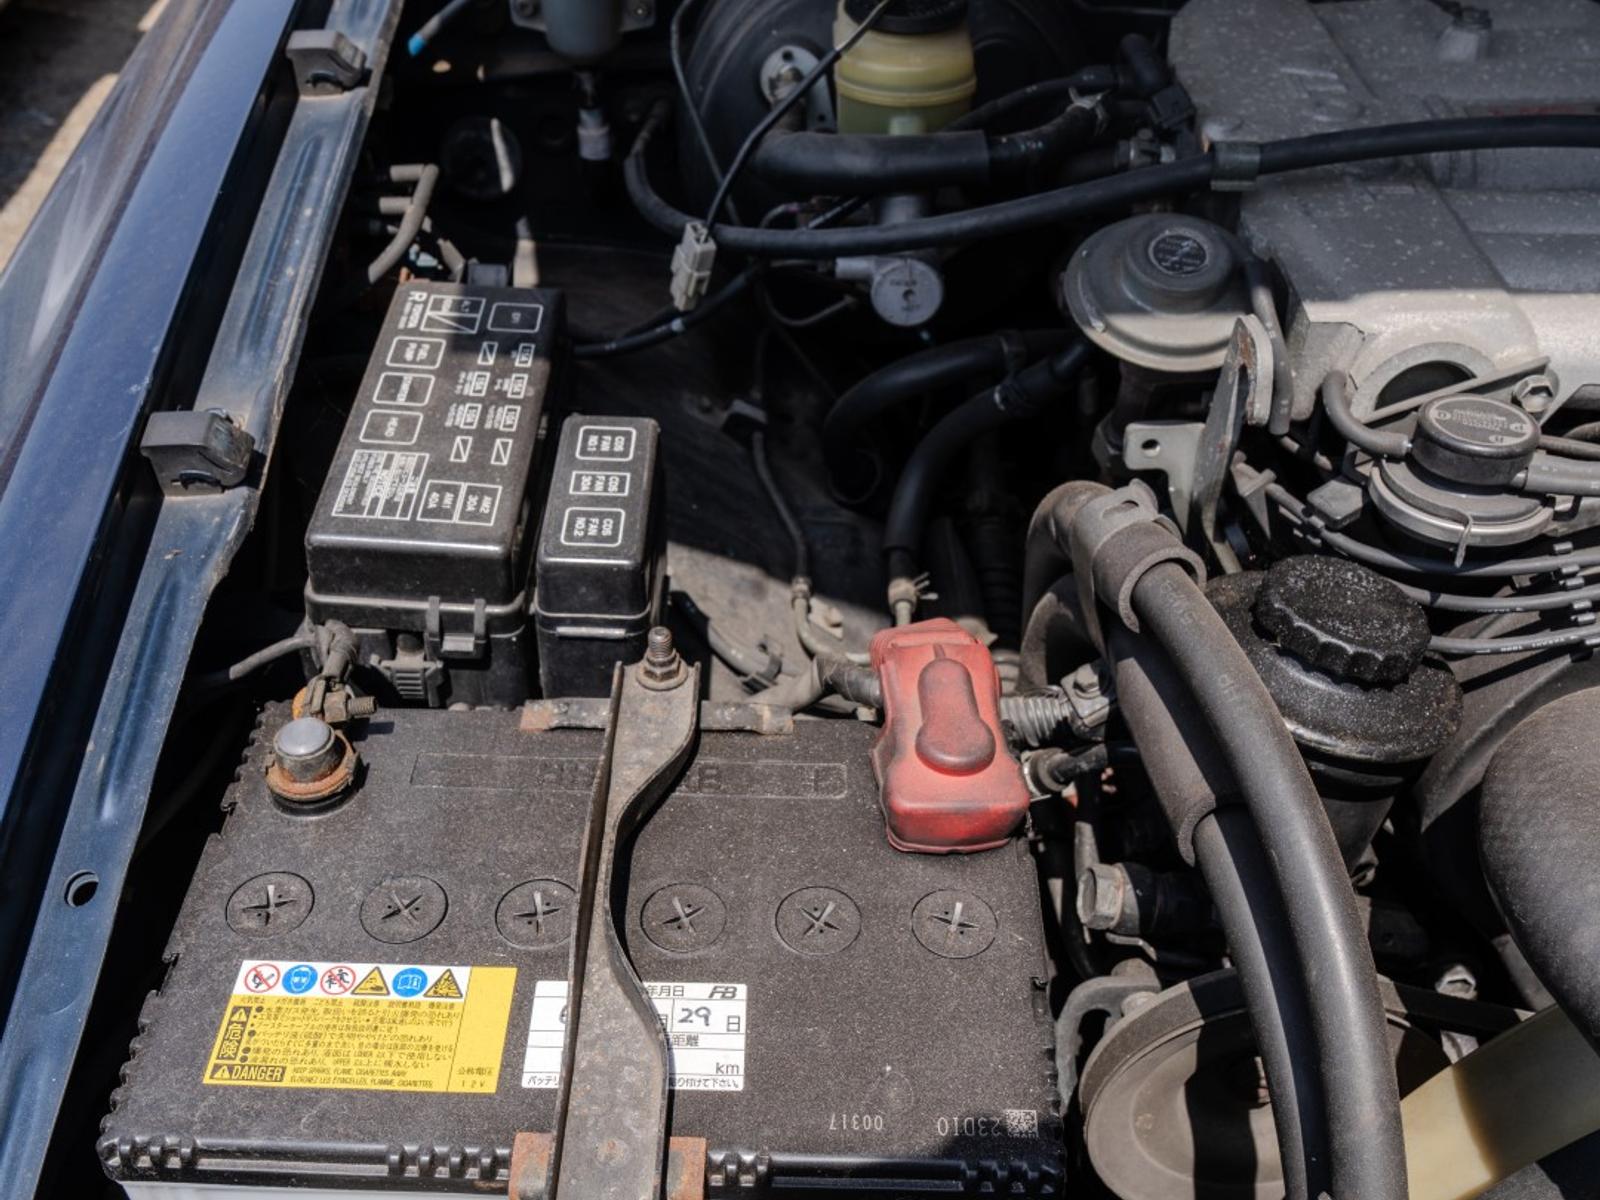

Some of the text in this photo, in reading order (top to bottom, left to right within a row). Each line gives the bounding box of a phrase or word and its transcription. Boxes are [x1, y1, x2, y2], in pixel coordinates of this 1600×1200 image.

[384, 416, 399, 438] HEAD
[600, 435, 612, 452] FAN
[580, 475, 593, 491] 30A
[594, 475, 606, 492] FAN
[426, 491, 440, 509] 40A
[440, 491, 455, 509] AM1
[465, 494, 479, 512] 30A
[479, 495, 493, 514] AM2
[573, 517, 587, 537] NO.2
[587, 518, 600, 536] FAN
[708, 985, 738, 999] FB
[678, 1006, 711, 1027] 29
[727, 1015, 741, 1033] 日
[219, 1023, 244, 1059] 危険
[232, 1065, 283, 1081] DANGER
[715, 1062, 740, 1074] km
[829, 1113, 884, 1131] 00317
